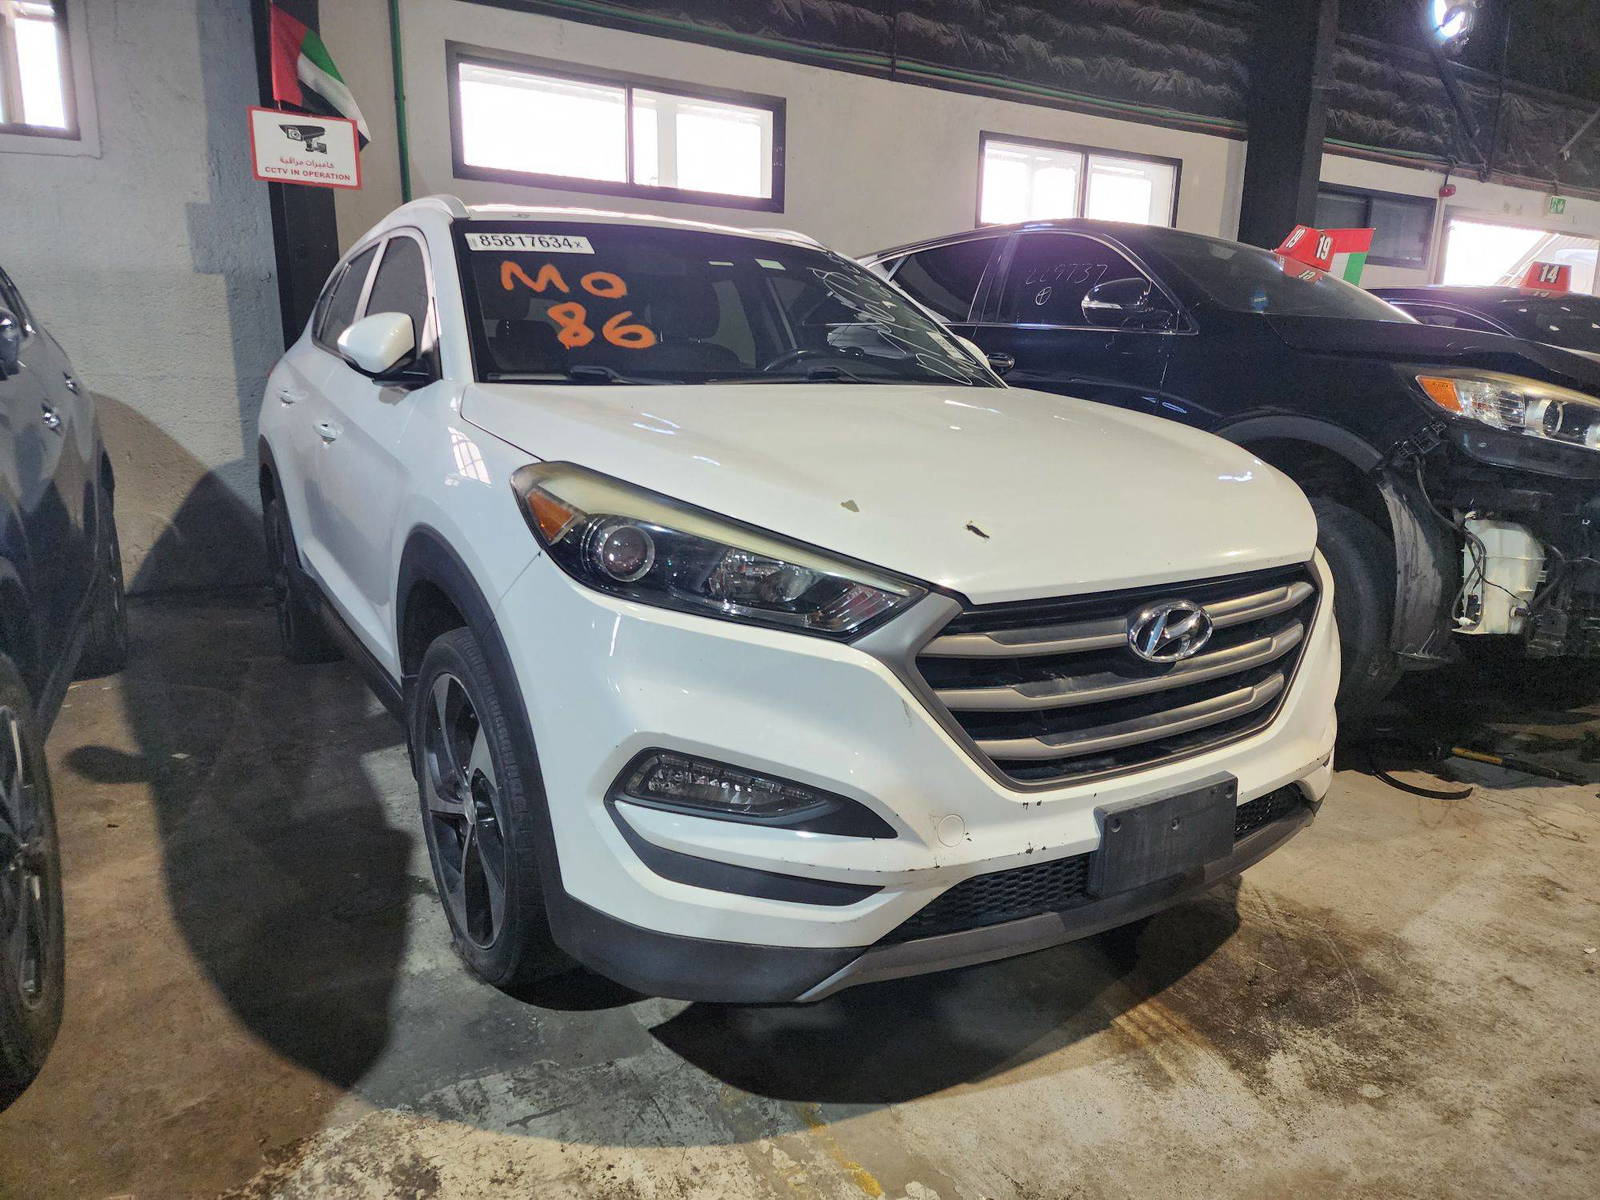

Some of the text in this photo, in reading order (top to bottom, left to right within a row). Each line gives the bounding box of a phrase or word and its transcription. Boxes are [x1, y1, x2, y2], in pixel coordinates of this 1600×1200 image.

[265, 166, 351, 181] CCTV IN OPERATION
[1316, 235, 1333, 260] 19
[1540, 264, 1560, 283] 14
[547, 301, 657, 350] 86
